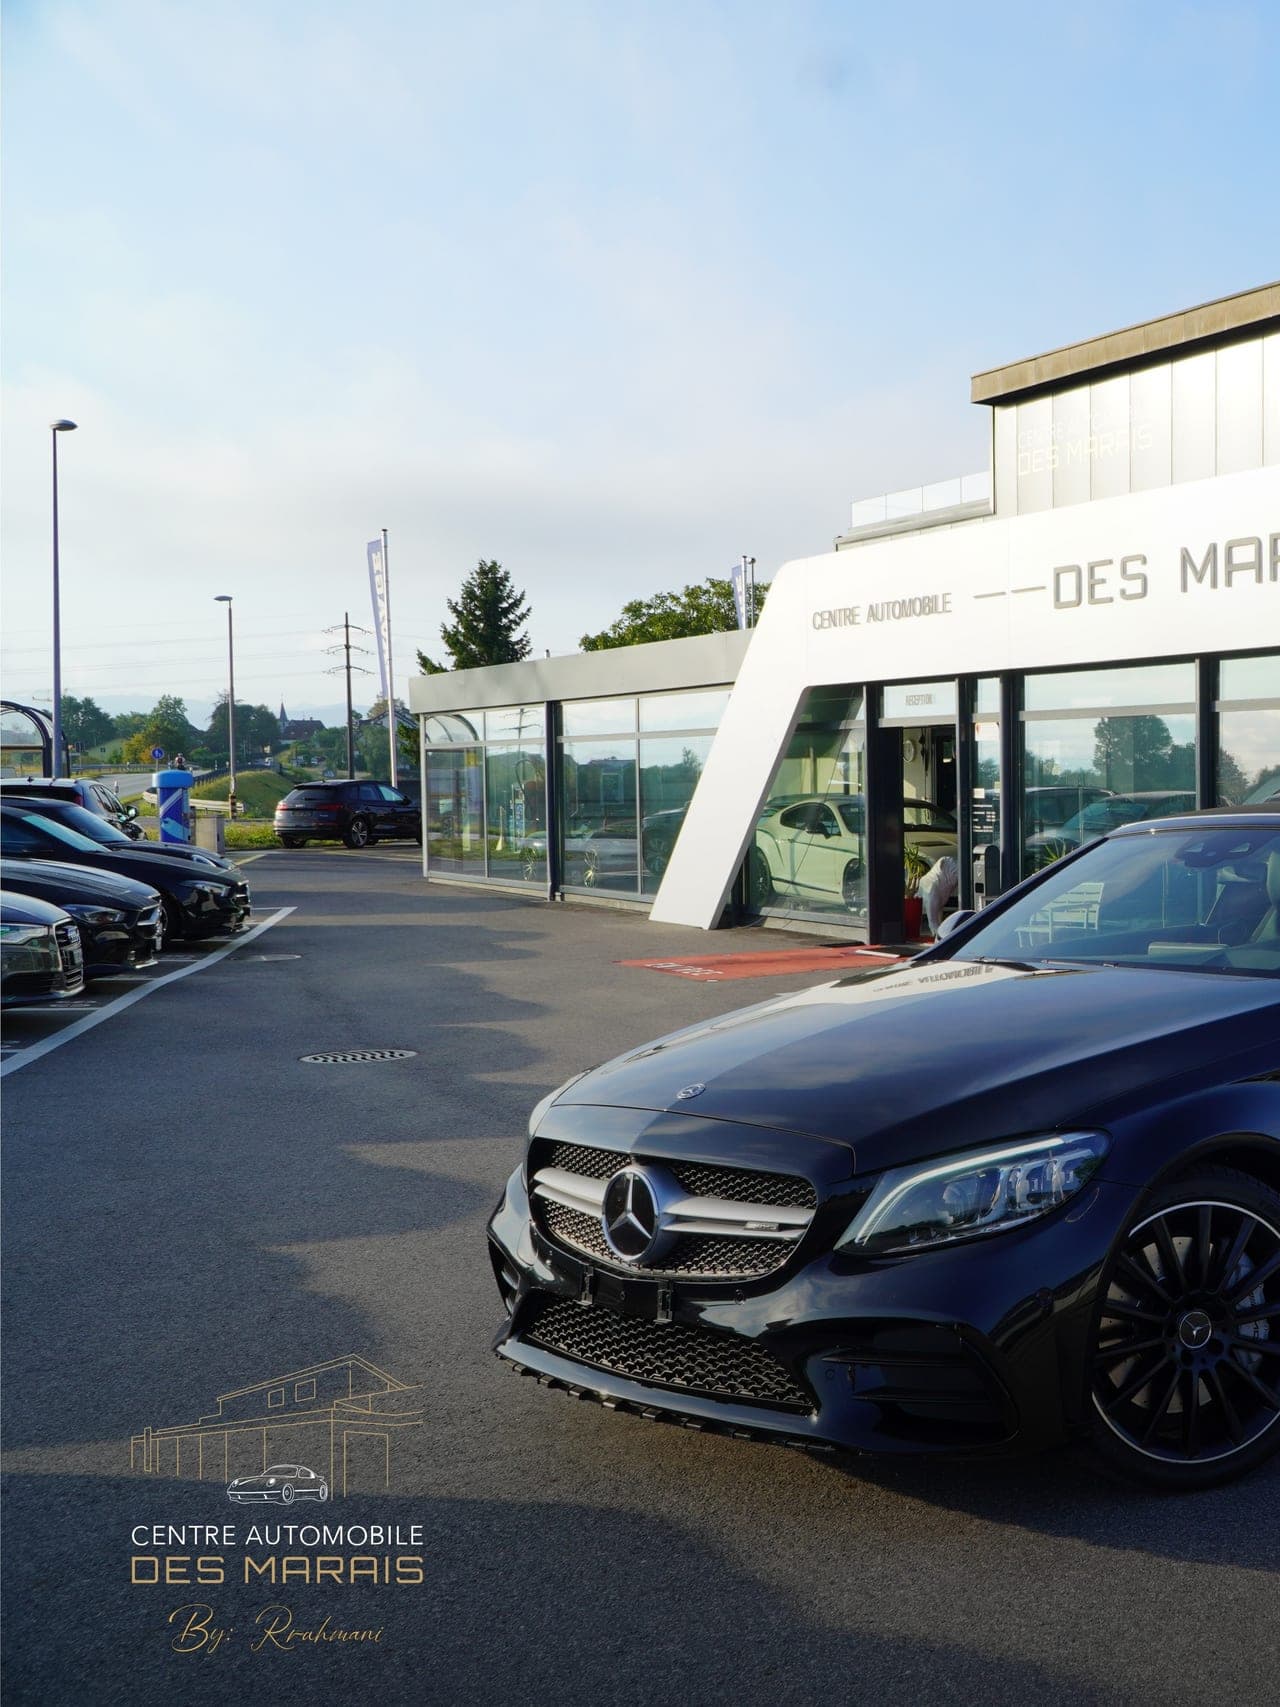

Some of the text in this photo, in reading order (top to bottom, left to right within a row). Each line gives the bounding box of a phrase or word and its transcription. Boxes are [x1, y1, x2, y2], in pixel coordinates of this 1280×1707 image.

[1018, 424, 1153, 476] DES MARAIS
[812, 606, 861, 630] CENTRE
[866, 592, 952, 623] AUTOMOBILE
[1053, 554, 1148, 610] DES
